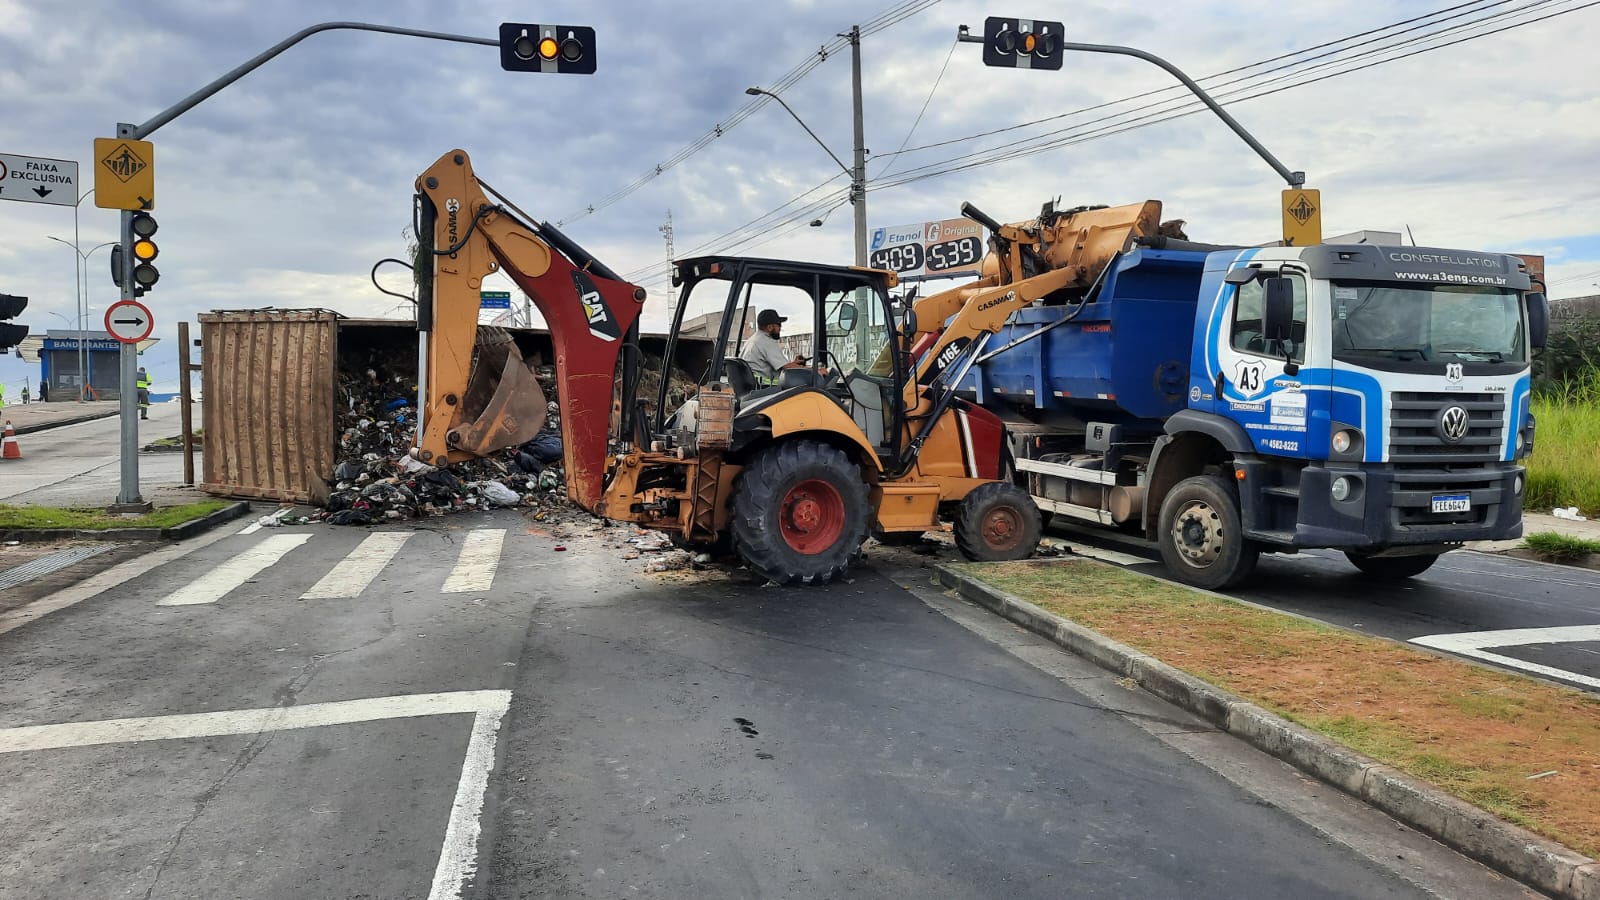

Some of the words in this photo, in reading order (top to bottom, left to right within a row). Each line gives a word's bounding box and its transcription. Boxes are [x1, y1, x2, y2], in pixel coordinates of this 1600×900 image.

[26, 161, 58, 172] FAIXA
[11, 170, 73, 185] EXCLUSIVA
[889, 230, 921, 243] Etanol
[944, 226, 978, 237] Original
[1389, 252, 1502, 268] CONSTELLATION
[1394, 270, 1508, 286] www.a3eng.com.br
[582, 290, 608, 325] CAT
[53, 340, 120, 349] BANDIRANTES
[937, 342, 961, 370] 416E
[1240, 366, 1260, 391] A3
[1449, 366, 1460, 380] A3
